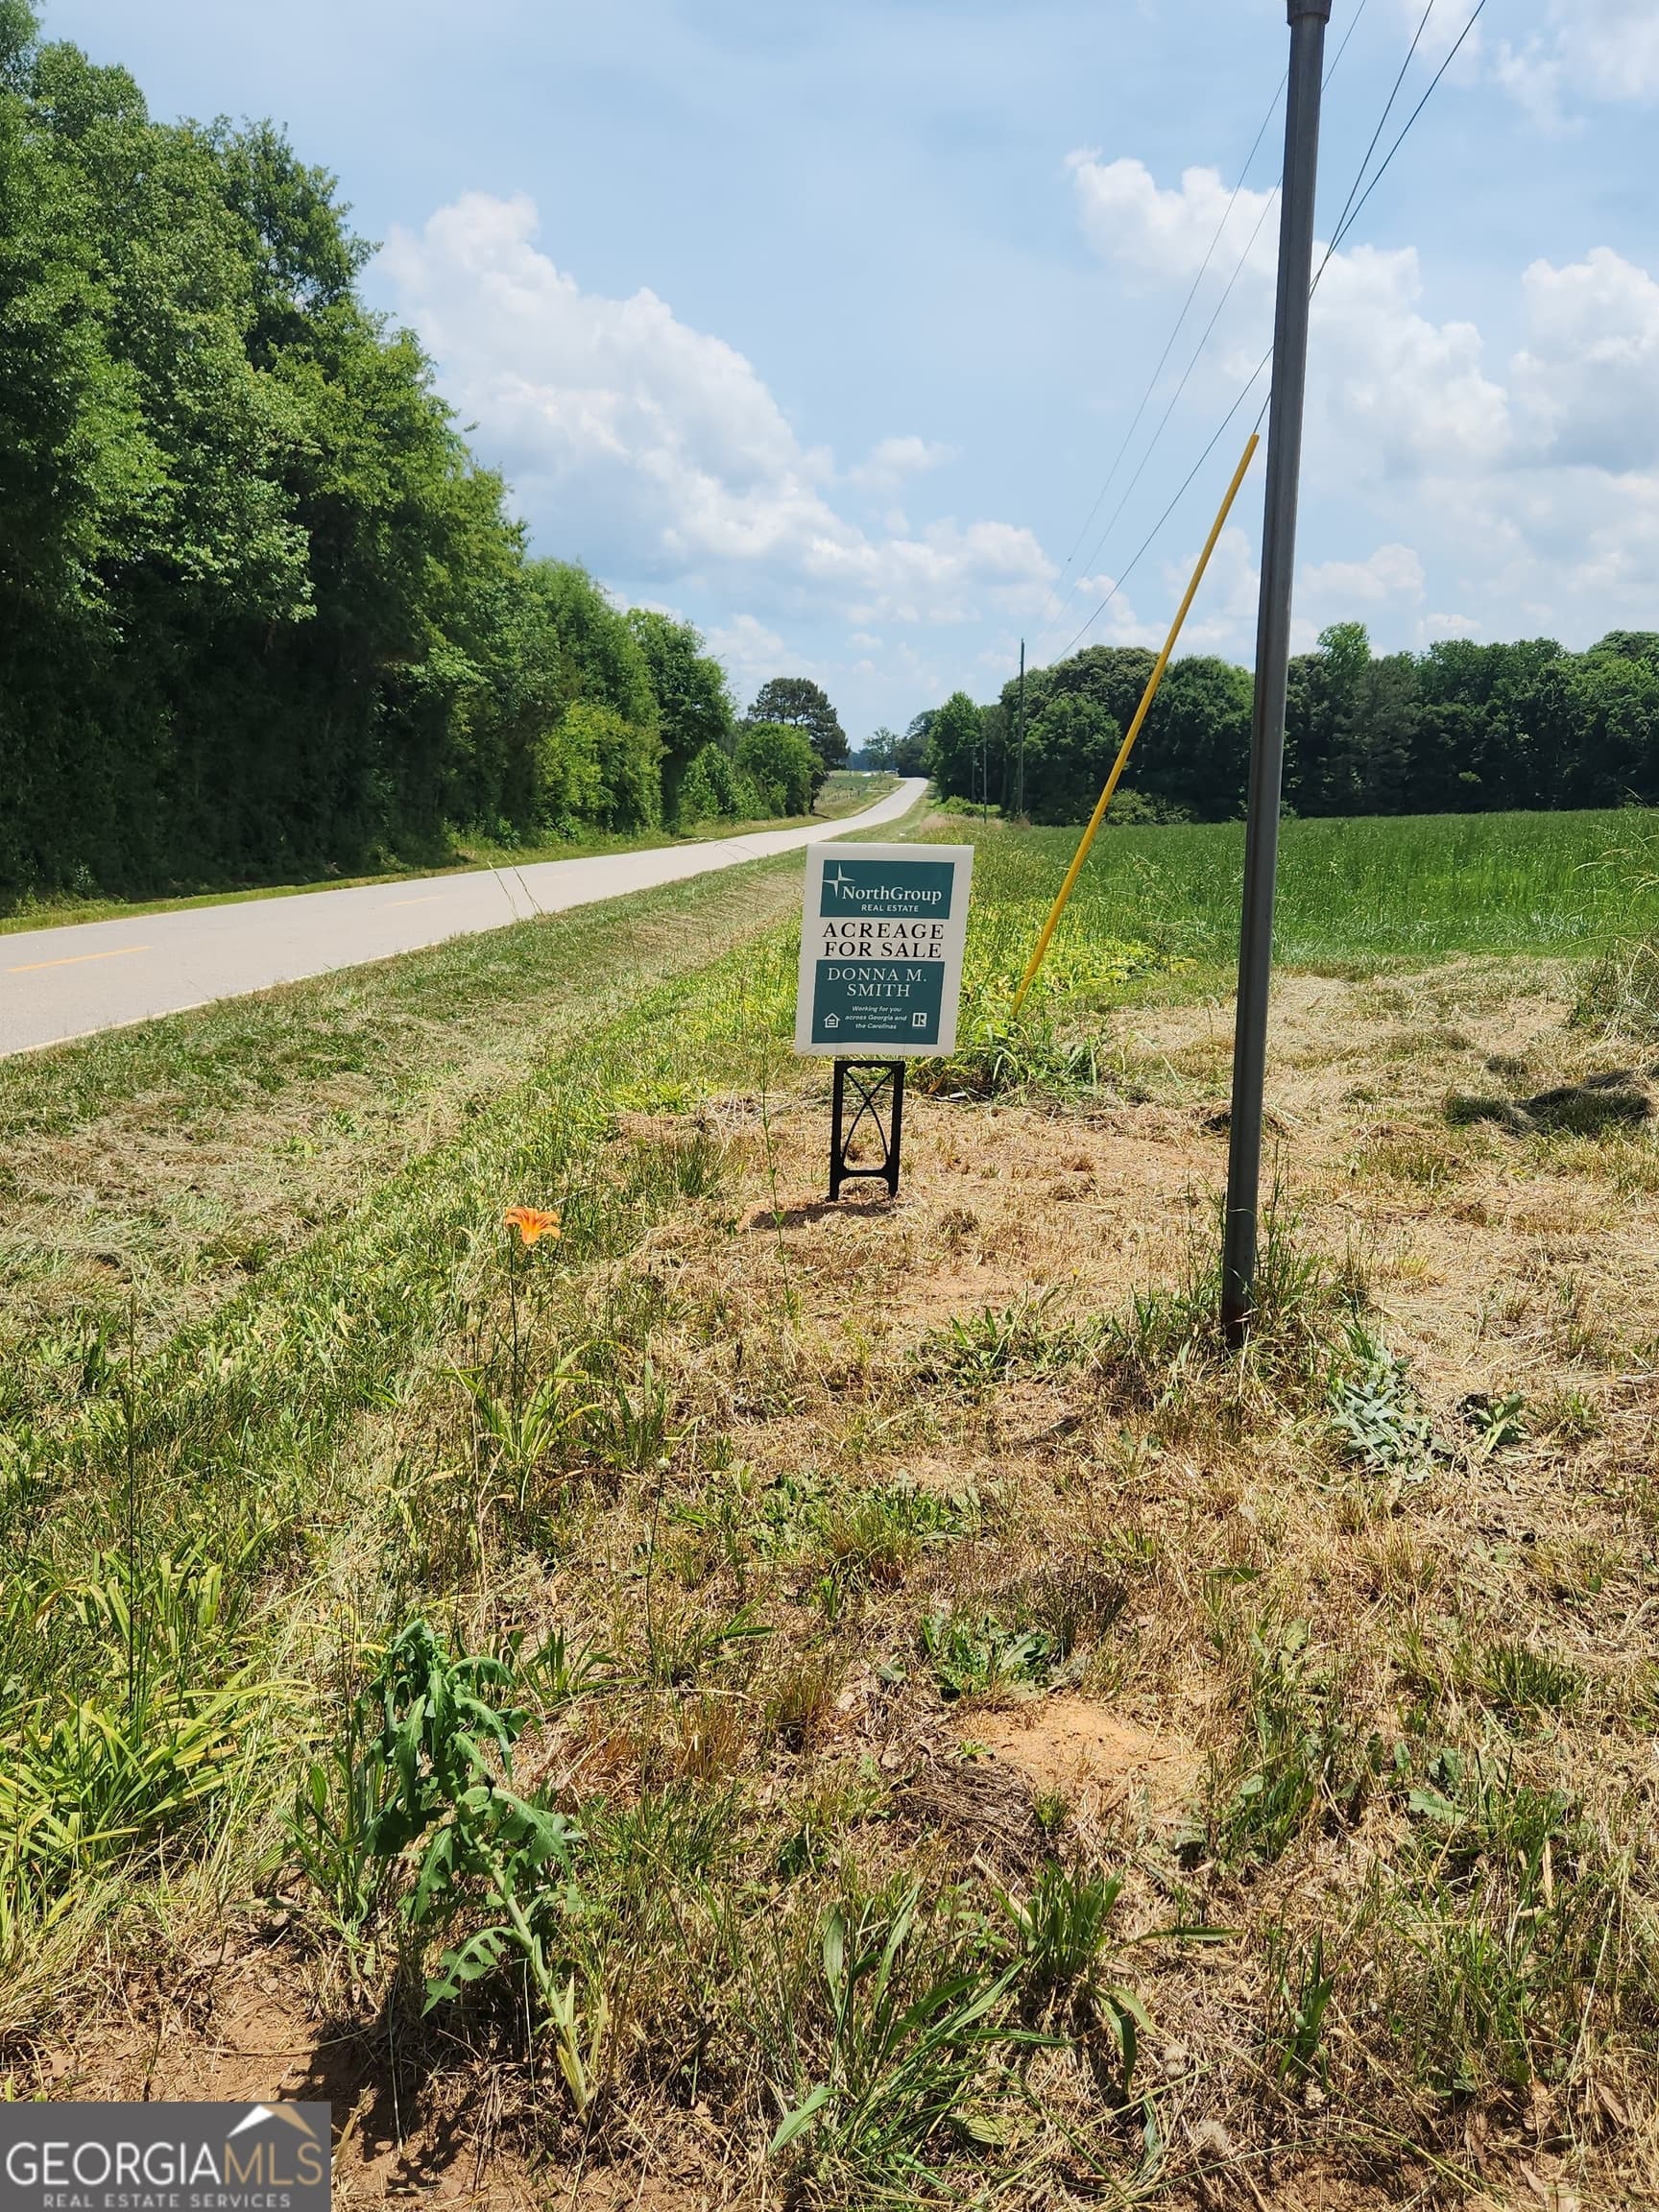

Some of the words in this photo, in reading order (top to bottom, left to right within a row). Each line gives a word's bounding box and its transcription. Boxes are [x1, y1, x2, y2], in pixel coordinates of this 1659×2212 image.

[842, 886, 942, 904] NorthGroup
[823, 923, 944, 939] ACREAGE
[824, 941, 873, 957] FOR
[880, 942, 942, 958] SALE
[827, 968, 899, 981] DONNA
[905, 969, 927, 981] M.
[847, 984, 911, 997] SMITH
